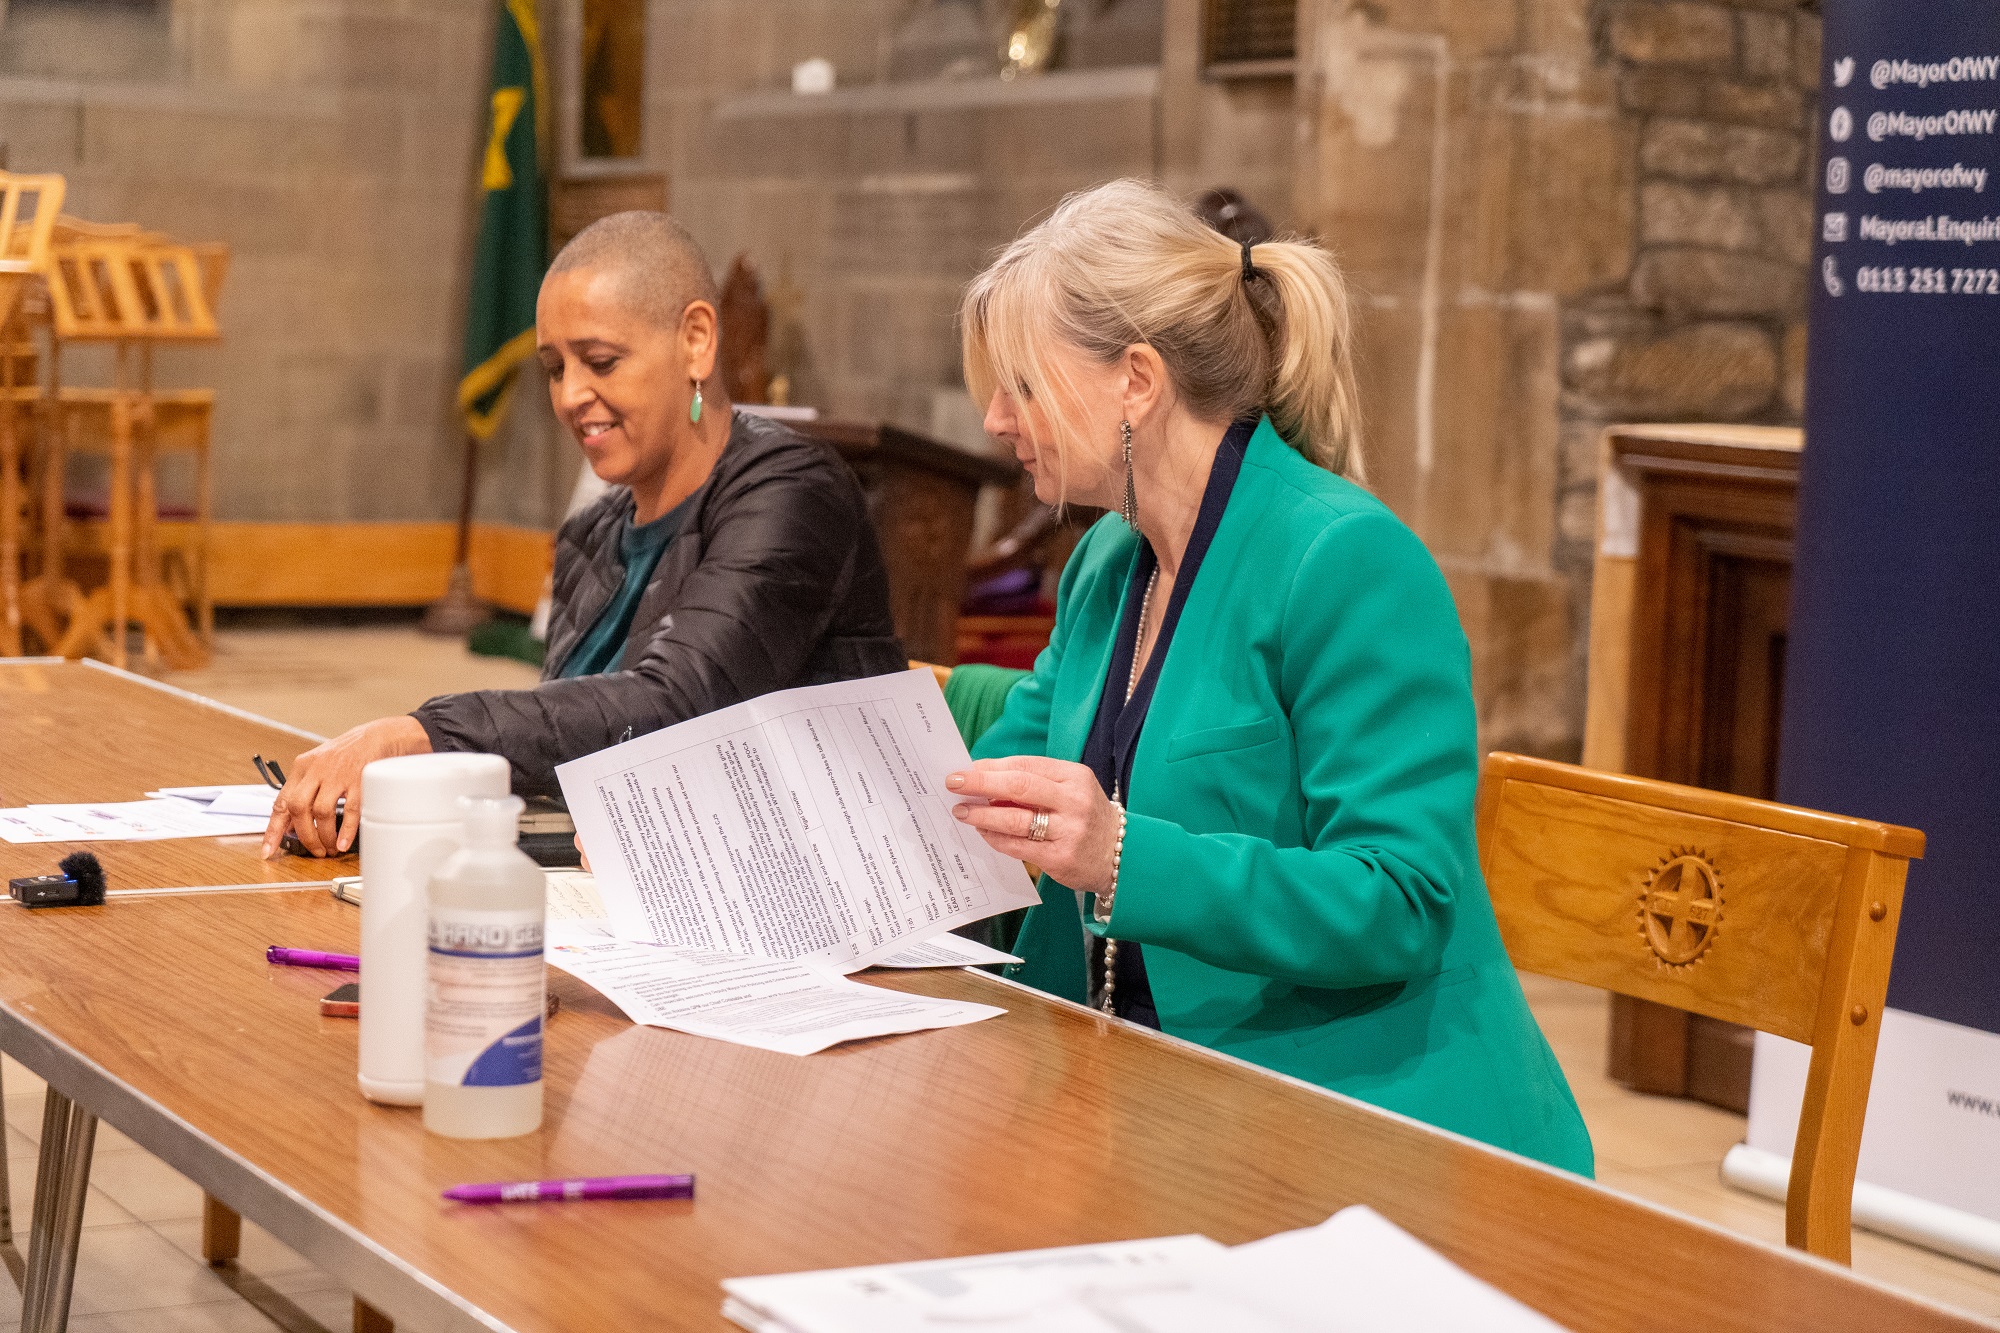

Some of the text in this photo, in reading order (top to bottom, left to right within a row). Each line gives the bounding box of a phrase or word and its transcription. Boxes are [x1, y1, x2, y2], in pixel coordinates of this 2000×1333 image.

[1870, 55, 1999, 90] @MayorOfWY
[1867, 109, 1997, 142] @MayorOfWY
[1864, 162, 1988, 194] @mayorofwy
[1857, 266, 2000, 295] 0113 251 7272
[924, 719, 932, 733] Page
[809, 727, 820, 742] about
[870, 733, 881, 748] about
[715, 744, 727, 762] giving
[742, 741, 753, 759] POCA
[816, 742, 824, 753] talk
[877, 748, 887, 761] more
[894, 744, 903, 756] from
[749, 758, 757, 769] the
[899, 756, 908, 768] hear
[724, 769, 733, 780] will
[753, 768, 763, 785] about
[758, 762, 773, 792] colleagues
[823, 759, 841, 797] Warren-Sykes
[908, 773, 920, 791] chance
[730, 780, 738, 793] who
[760, 785, 769, 800] more
[857, 771, 874, 804] Presentation
[769, 792, 779, 806] WYP
[838, 796, 847, 810] Julie
[735, 792, 753, 830] organisations
[768, 807, 776, 817] tell
[775, 806, 783, 816] our
[790, 790, 810, 831] Nigel Crowther
[842, 810, 852, 825] night
[773, 816, 781, 828] can
[779, 816, 788, 828] that
[777, 827, 786, 840] who
[784, 827, 793, 842] work
[882, 834, 891, 848] trust
[917, 833, 930, 853] second
[782, 840, 796, 866] Crowther
[790, 842, 803, 866] fantastic
[816, 853, 824, 866] how
[855, 841, 867, 863] speaker
[888, 848, 898, 865] Sykes
[926, 853, 934, 863] our
[627, 799, 685, 946] Communities Fund brings together money seized from
[761, 859, 770, 874] from
[791, 865, 802, 881] Nigel
[799, 865, 807, 876] the
[820, 865, 828, 876] and
[863, 863, 872, 876] first
[869, 860, 878, 871] will
[802, 875, 811, 886] and
[824, 876, 833, 886] Act
[868, 875, 876, 885] our
[874, 870, 885, 886] grant
[894, 864, 908, 893] Samantha
[929, 843, 960, 912] LEAD advocate programme
[930, 862, 944, 888] introduce
[767, 873, 779, 895] hearing
[798, 880, 807, 894] from
[812, 880, 821, 895] from
[804, 894, 812, 907] hear
[807, 886, 817, 902] detail
[829, 886, 839, 904] Crime
[833, 880, 848, 908] recovered
[873, 885, 886, 911] introduce
[940, 888, 948, 900] now
[646, 868, 676, 944] intervention and prevention
[777, 902, 786, 913] will
[814, 902, 823, 917] more
[818, 894, 829, 915] monies
[883, 895, 893, 910] what
[946, 902, 954, 915] Can
[883, 911, 891, 923] now
[888, 909, 897, 920] and
[924, 903, 935, 921] Alison
[931, 902, 941, 920] Thank
[839, 910, 852, 937] Proceeds
[848, 914, 858, 933] money
[893, 920, 903, 936] Trust
[443, 921, 508, 949] HAND
[785, 921, 798, 944] evening
[822, 923, 836, 946] process
[829, 924, 841, 944] extract
[868, 928, 879, 946] Alison
[874, 926, 884, 944] Thank
[889, 926, 897, 939] Can
[820, 937, 828, 948] But
[794, 944, 802, 957] This
